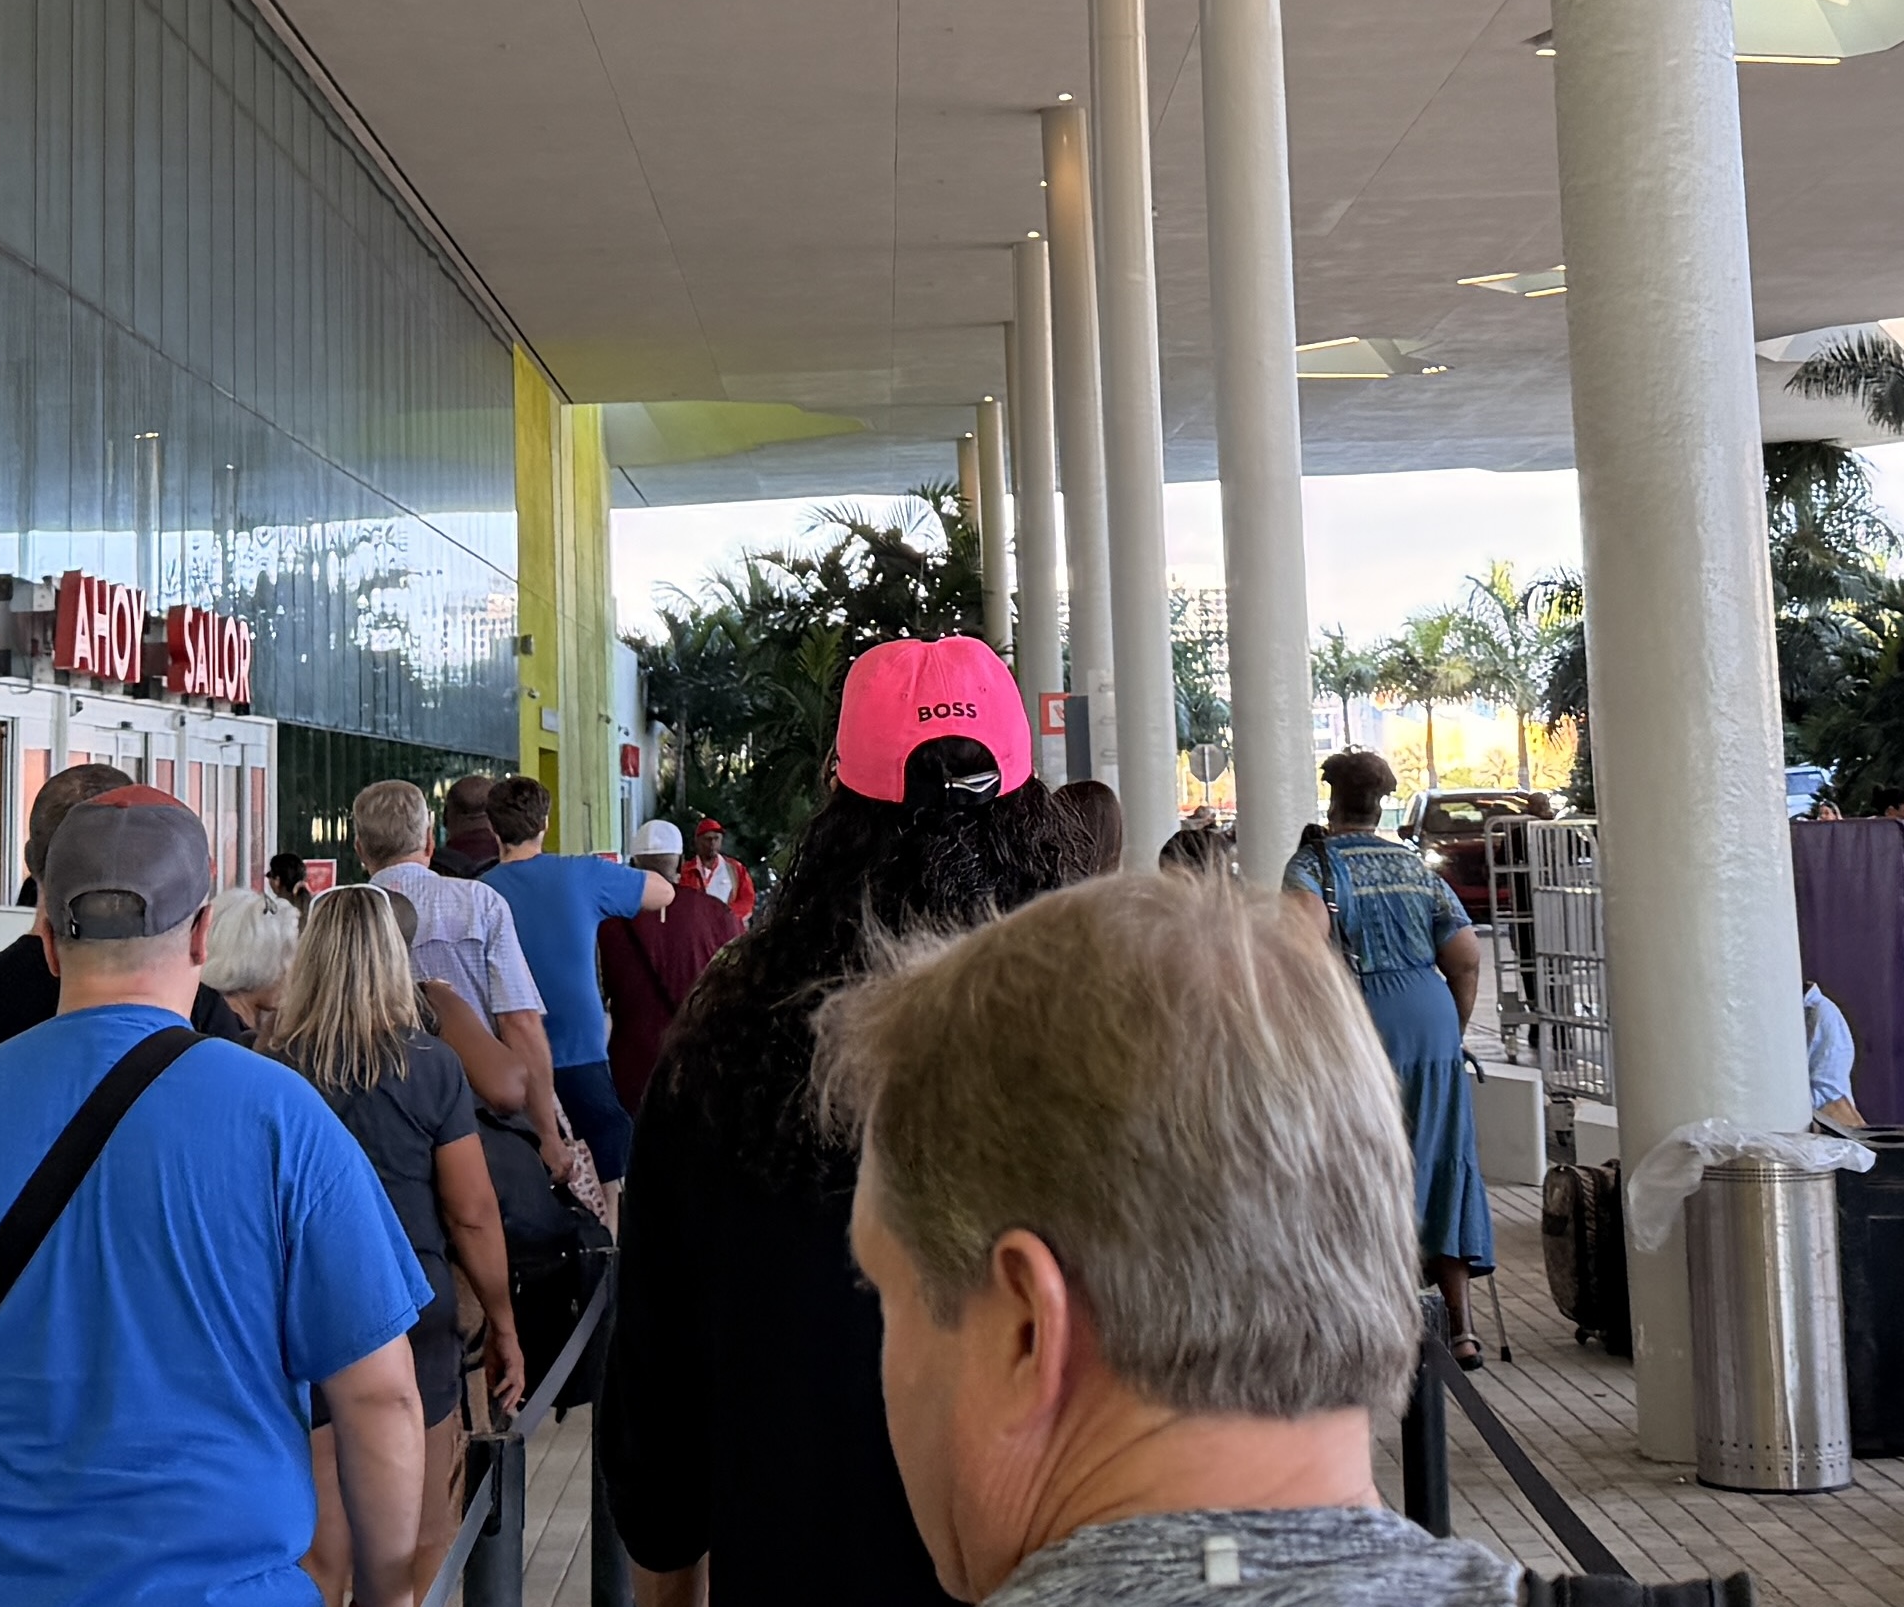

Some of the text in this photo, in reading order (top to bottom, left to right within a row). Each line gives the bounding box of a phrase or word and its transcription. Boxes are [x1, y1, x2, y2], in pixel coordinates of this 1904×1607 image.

[72, 577, 252, 704] AHOY SAILOR
[917, 701, 978, 723] BOSS
